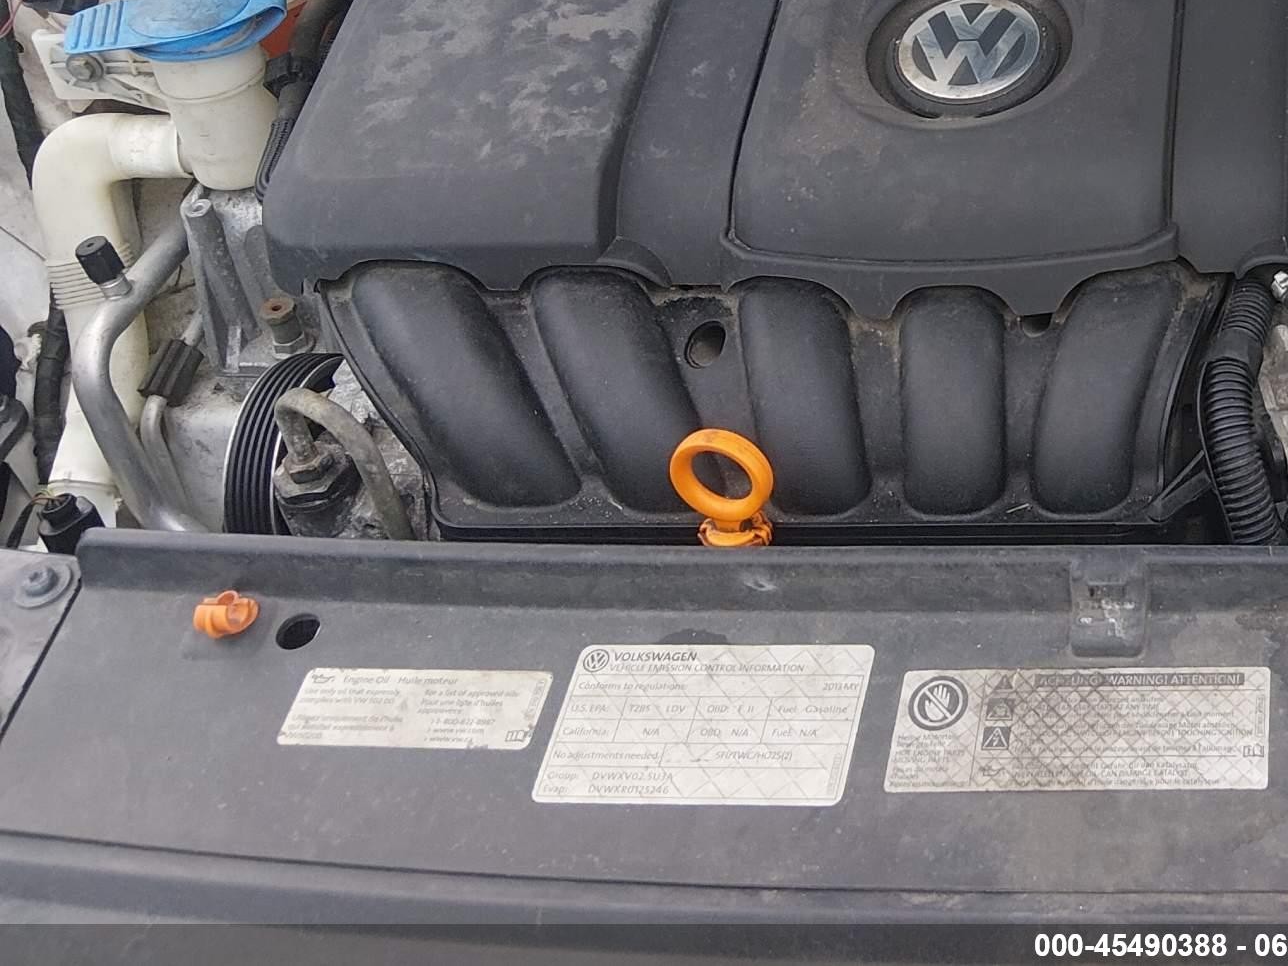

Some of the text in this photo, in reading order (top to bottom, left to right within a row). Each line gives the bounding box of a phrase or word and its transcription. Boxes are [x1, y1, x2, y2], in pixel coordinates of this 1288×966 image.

[613, 651, 698, 662] VOLKSWAGEN
[609, 664, 645, 672] VEHICLE
[648, 664, 692, 672] EMISSION
[738, 664, 805, 672] INFORMATION
[343, 675, 391, 685] Engine Oil
[398, 676, 458, 685] Huile moteur
[1108, 674, 1168, 685] WARNING!
[1170, 674, 1240, 685] ATTENTION!
[578, 682, 622, 691] Conforms
[623, 682, 634, 691] to
[805, 705, 848, 714] Gasoline
[642, 727, 660, 736] N/A
[730, 728, 749, 737] N/A
[799, 728, 817, 737] N/A
[552, 751, 566, 759] No
